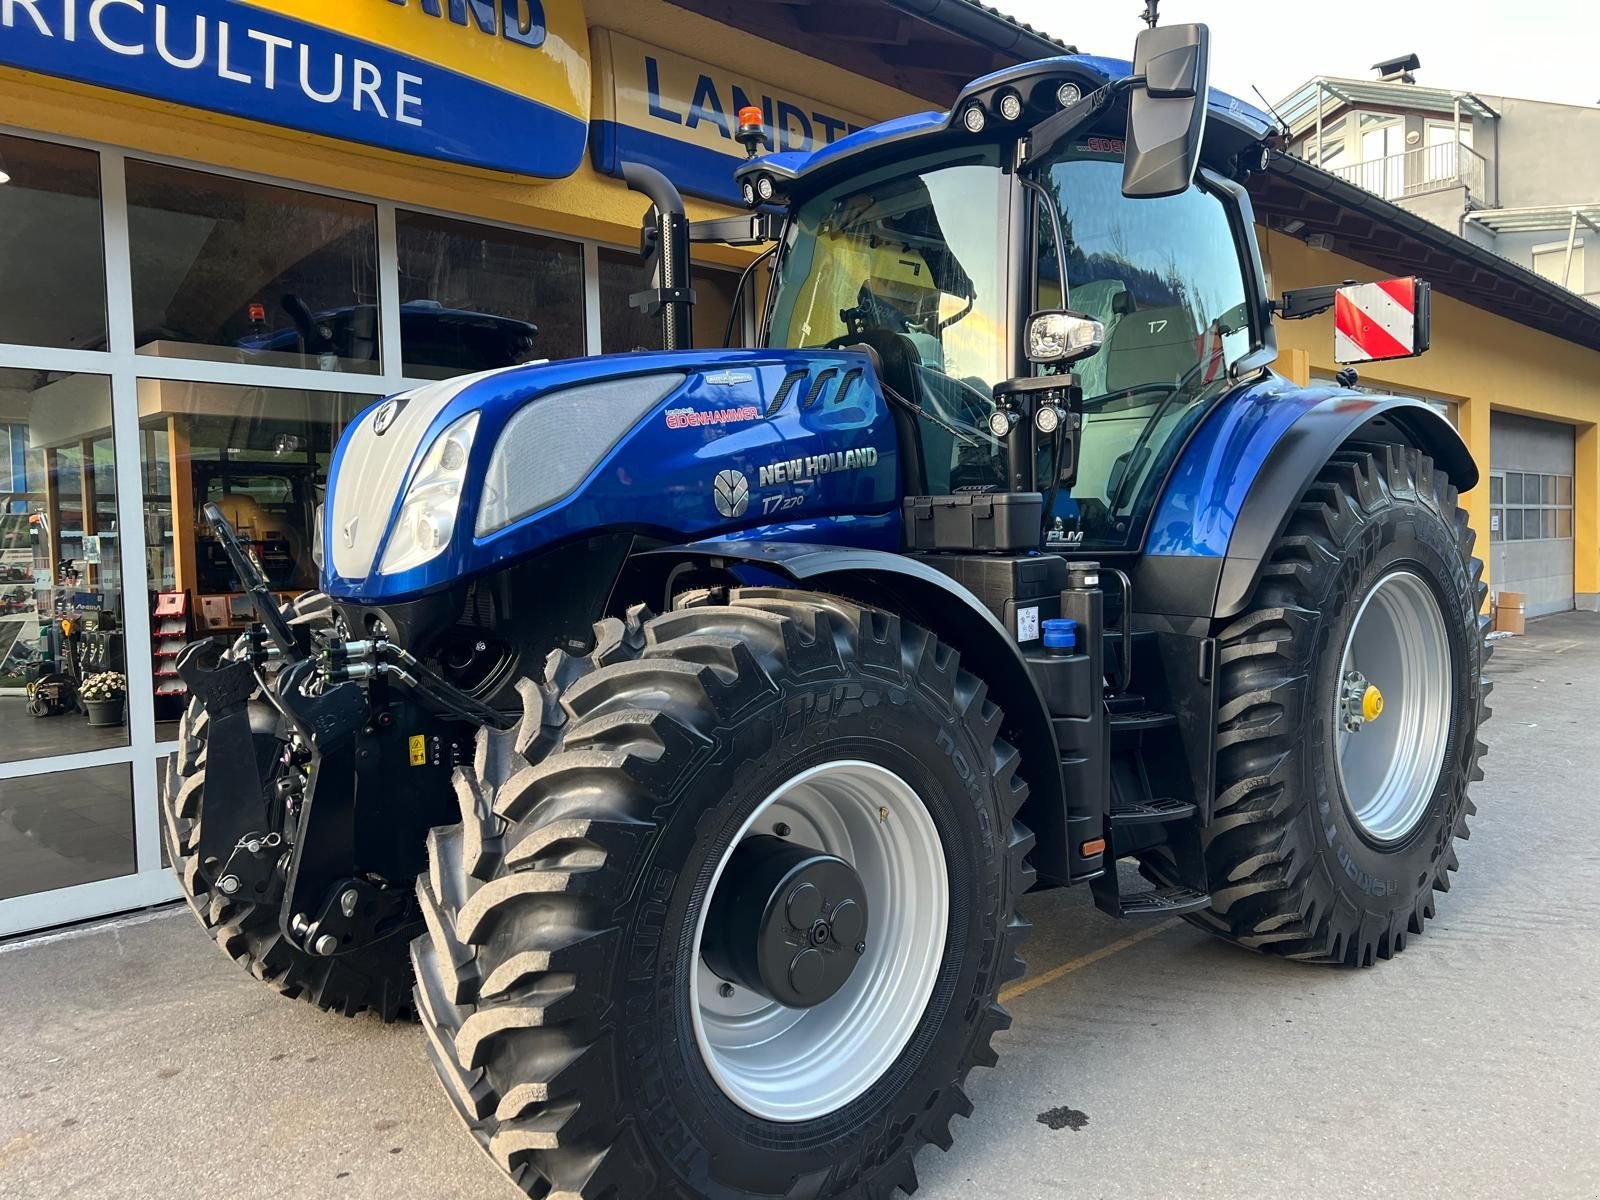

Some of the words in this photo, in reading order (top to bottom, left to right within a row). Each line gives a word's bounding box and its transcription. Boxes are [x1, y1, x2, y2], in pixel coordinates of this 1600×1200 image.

[645, 56, 865, 153] LANDT
[1148, 319, 1168, 334] T7
[666, 406, 757, 429] EIDENHAMMER
[760, 459, 802, 487] NEW
[806, 447, 878, 477] HOLLAND
[1046, 531, 1084, 542] PLM
